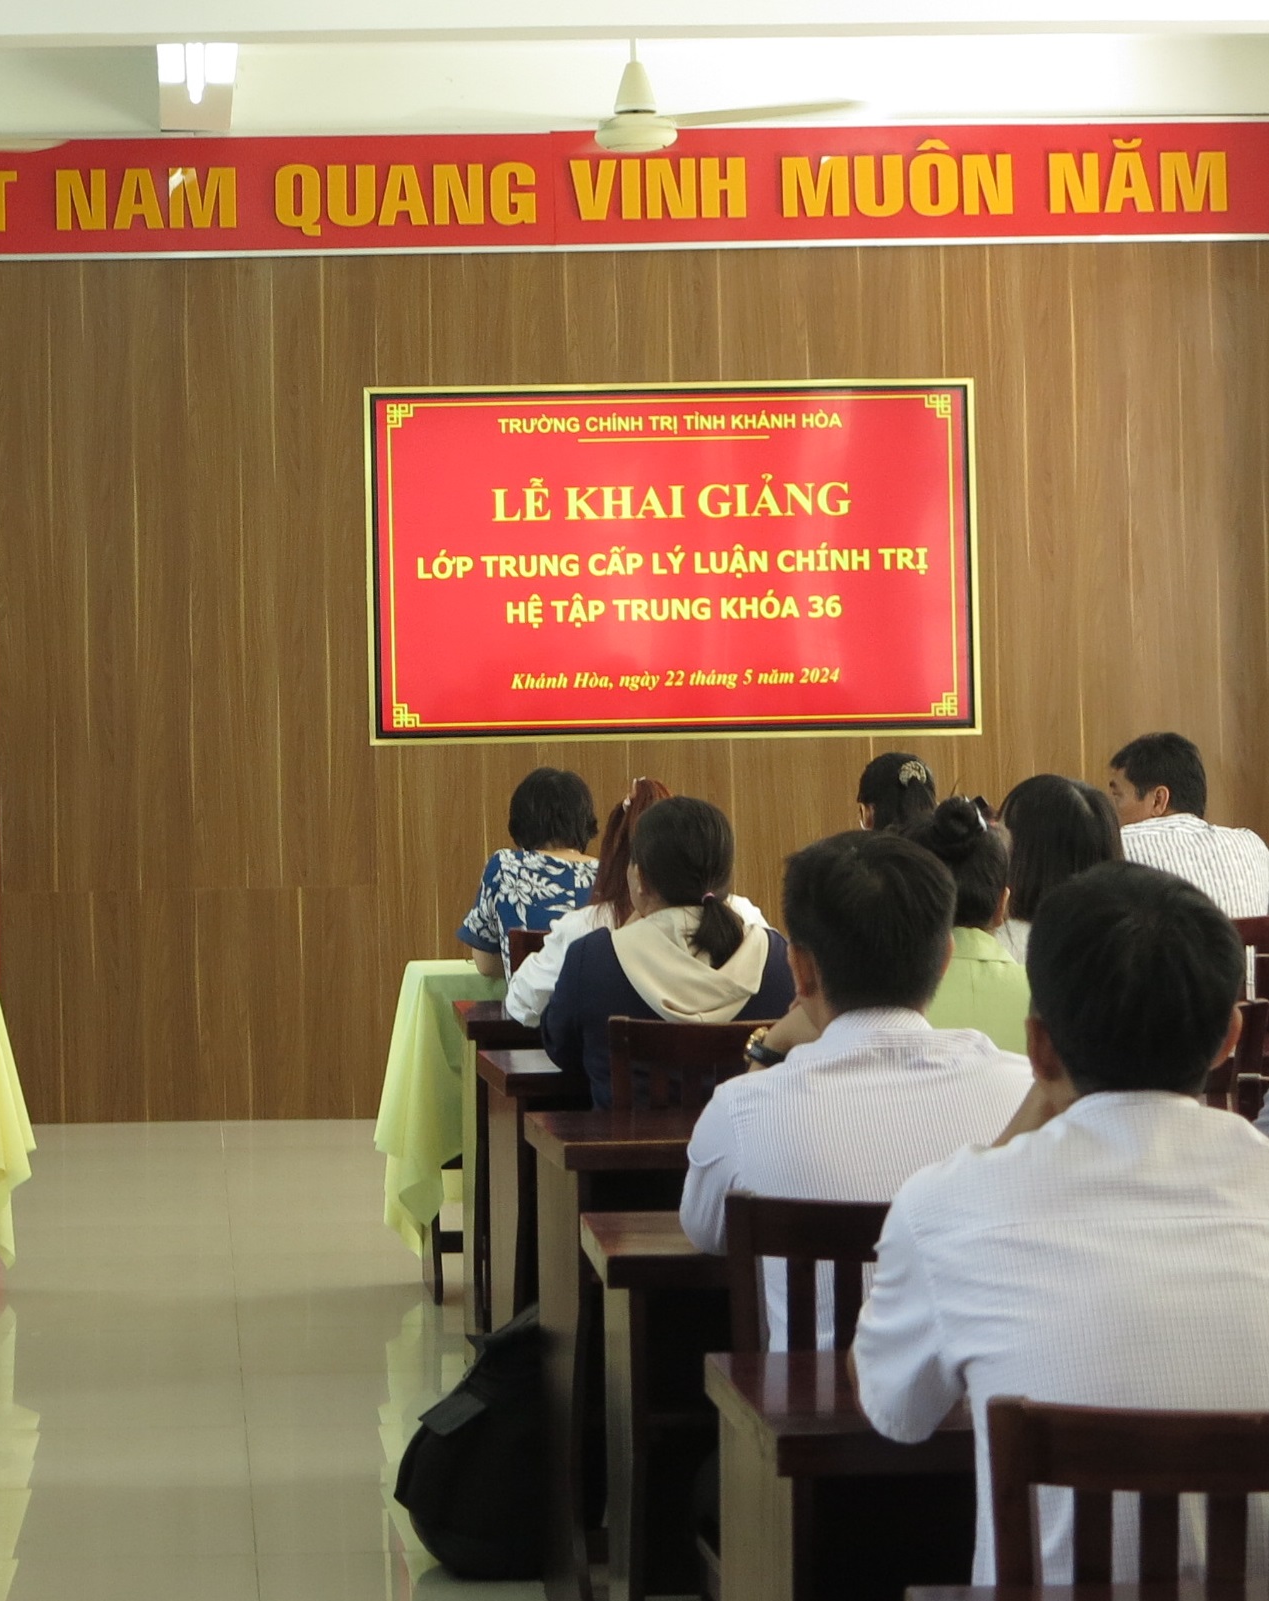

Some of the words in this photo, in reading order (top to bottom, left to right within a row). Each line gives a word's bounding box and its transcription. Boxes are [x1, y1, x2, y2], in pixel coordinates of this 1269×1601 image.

[55, 167, 237, 231] NAM
[274, 162, 537, 237] QUANG
[569, 157, 748, 221] VINH
[782, 138, 1014, 219] MUÔN
[1048, 138, 1228, 215] NĂM
[497, 416, 581, 434] TRƯỜNG
[585, 412, 644, 432] CHÍNH
[648, 415, 679, 435] TRỊ
[682, 411, 726, 431] TỈNH
[730, 409, 797, 430] KHÁNH
[801, 409, 844, 429] HÒA
[491, 477, 552, 522] LỄ
[563, 484, 686, 521] KHAI
[697, 472, 852, 519] GIẢNG
[416, 548, 474, 580] LỚP
[479, 553, 581, 579] TRUNG
[587, 545, 645, 577] CẤP
[651, 544, 686, 576] LÝ
[693, 543, 769, 579] LUẬN
[776, 541, 871, 573] CHÍNH
[877, 546, 930, 576] TRỊ
[506, 593, 544, 629] HỆ
[550, 592, 607, 629] TẬP
[612, 596, 712, 623] TRUNG
[719, 588, 801, 620] KHÓA
[807, 594, 843, 619] 36
[511, 672, 568, 690] Khánh
[573, 671, 614, 690] Hòa,
[618, 670, 661, 692] ngày
[664, 669, 685, 687] 22
[689, 669, 739, 689] tháng
[742, 668, 754, 685] 5
[757, 668, 795, 685] năm
[799, 666, 841, 684] 2024
